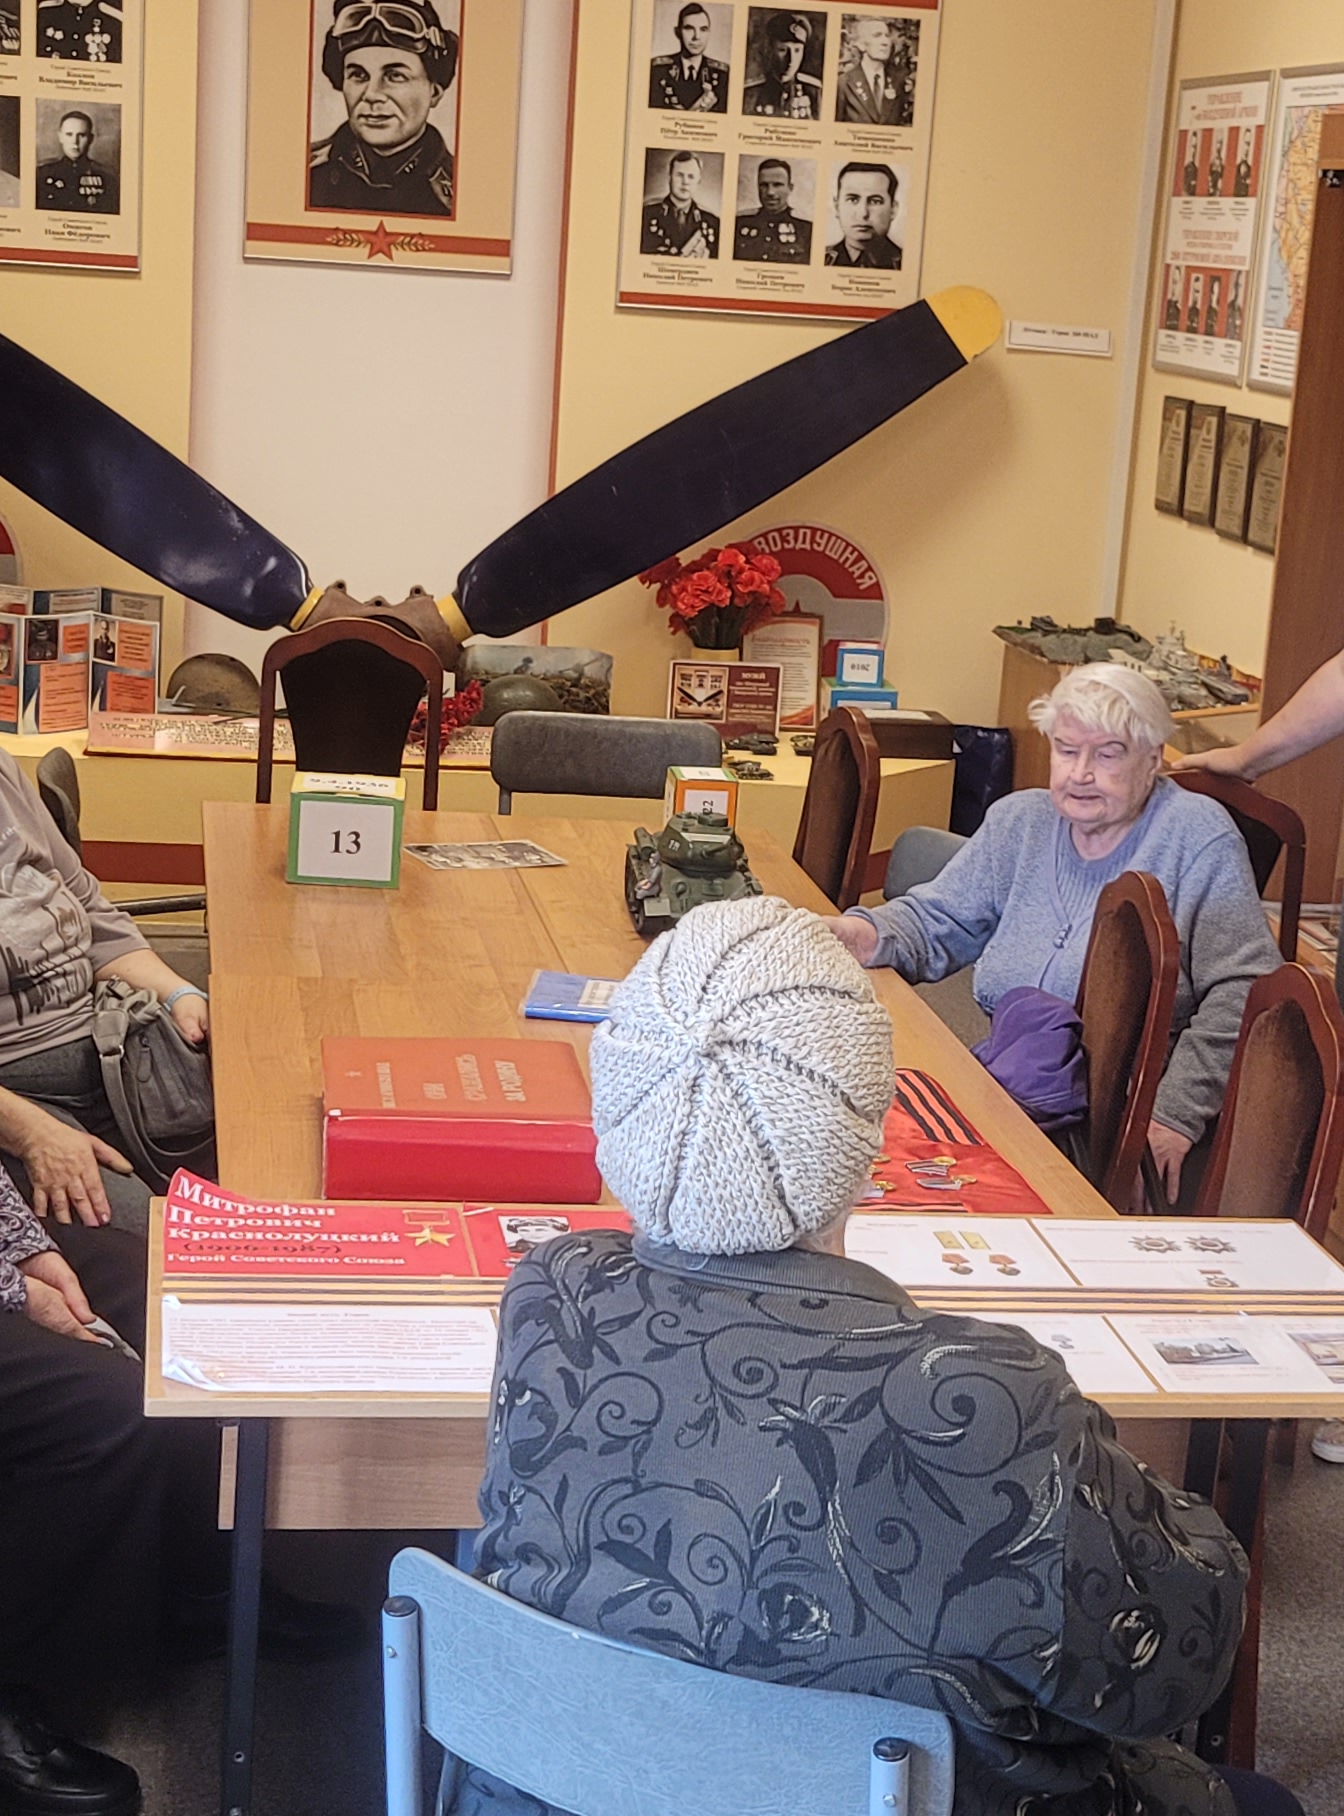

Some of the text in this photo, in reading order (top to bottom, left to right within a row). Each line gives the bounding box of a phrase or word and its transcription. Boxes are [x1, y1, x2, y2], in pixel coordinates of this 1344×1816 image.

[752, 528, 877, 590] ВОЗДУШНАЯ
[330, 829, 362, 855] 13
[173, 1174, 336, 1217] Митрофан
[167, 1203, 322, 1229] Петрович
[167, 1227, 401, 1244] Краснолуцкий
[167, 1252, 406, 1266] Герой Советского Союза
